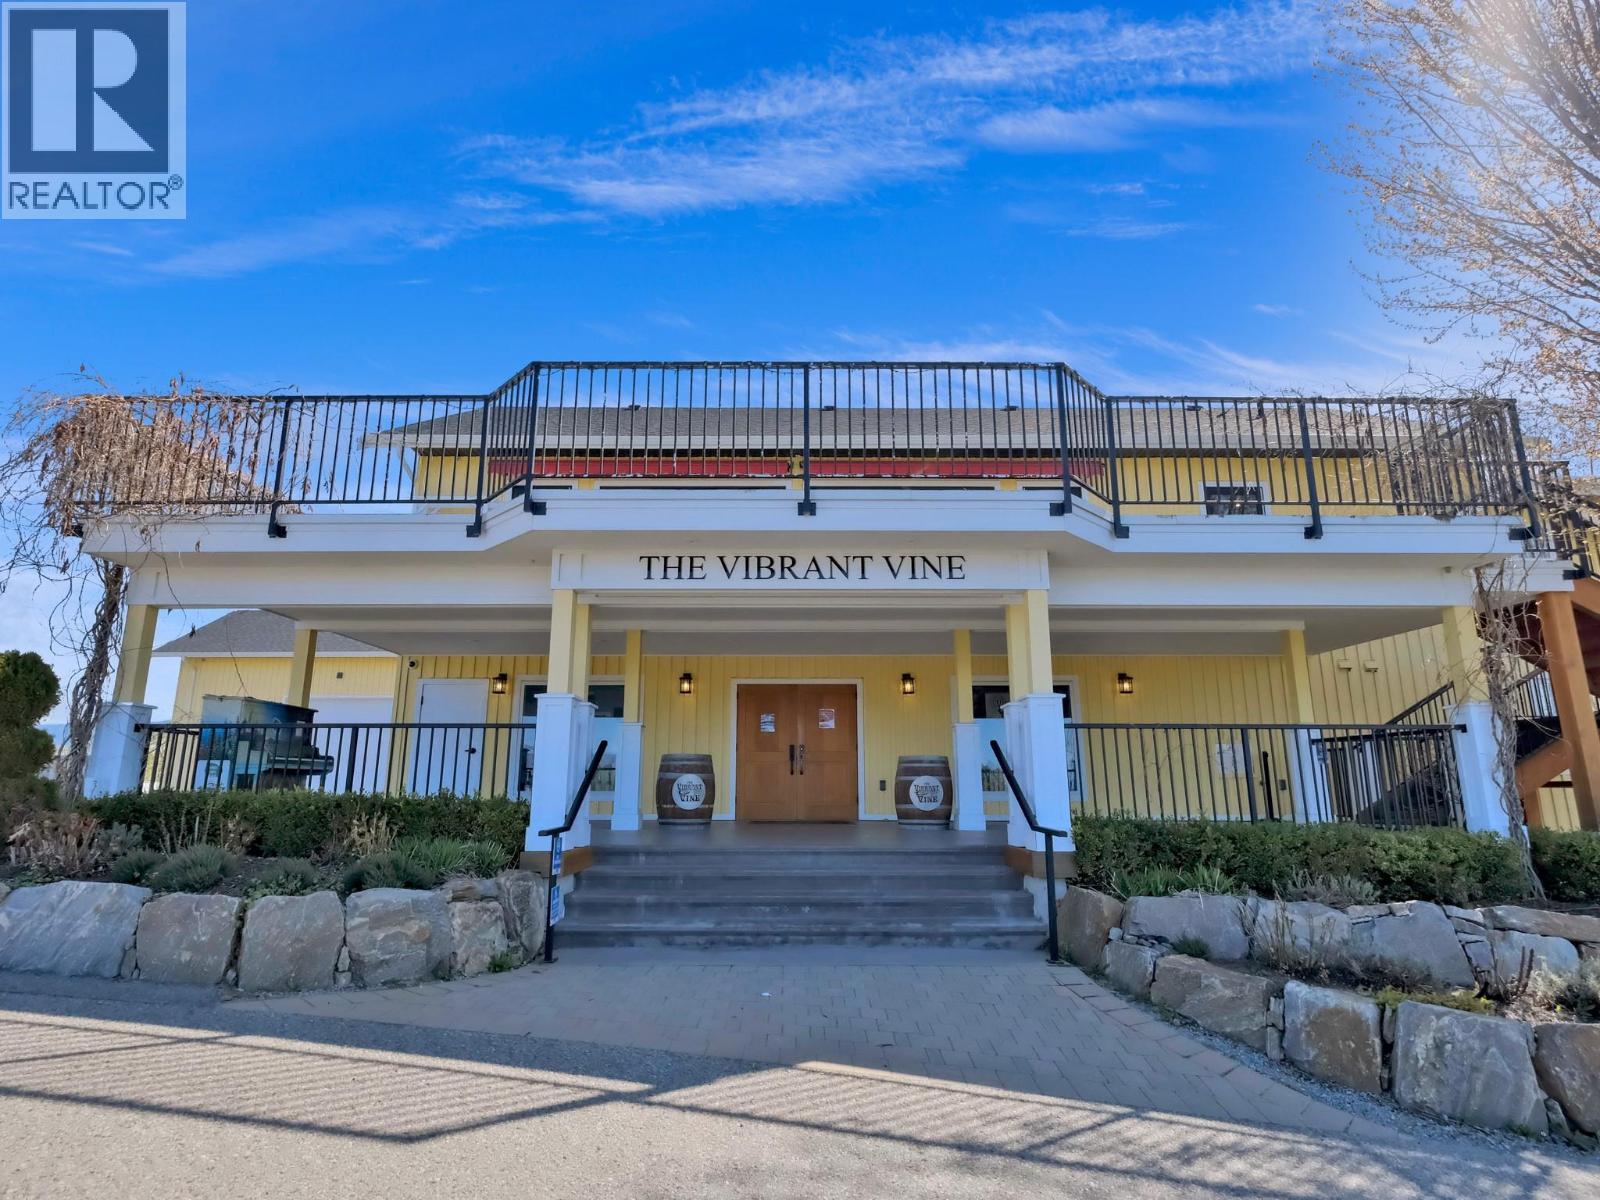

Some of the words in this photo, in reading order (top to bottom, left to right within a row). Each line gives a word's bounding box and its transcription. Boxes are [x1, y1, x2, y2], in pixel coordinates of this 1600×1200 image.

[639, 555, 707, 580] THE
[717, 555, 874, 580] VIBRANT
[883, 555, 967, 580] VINE
